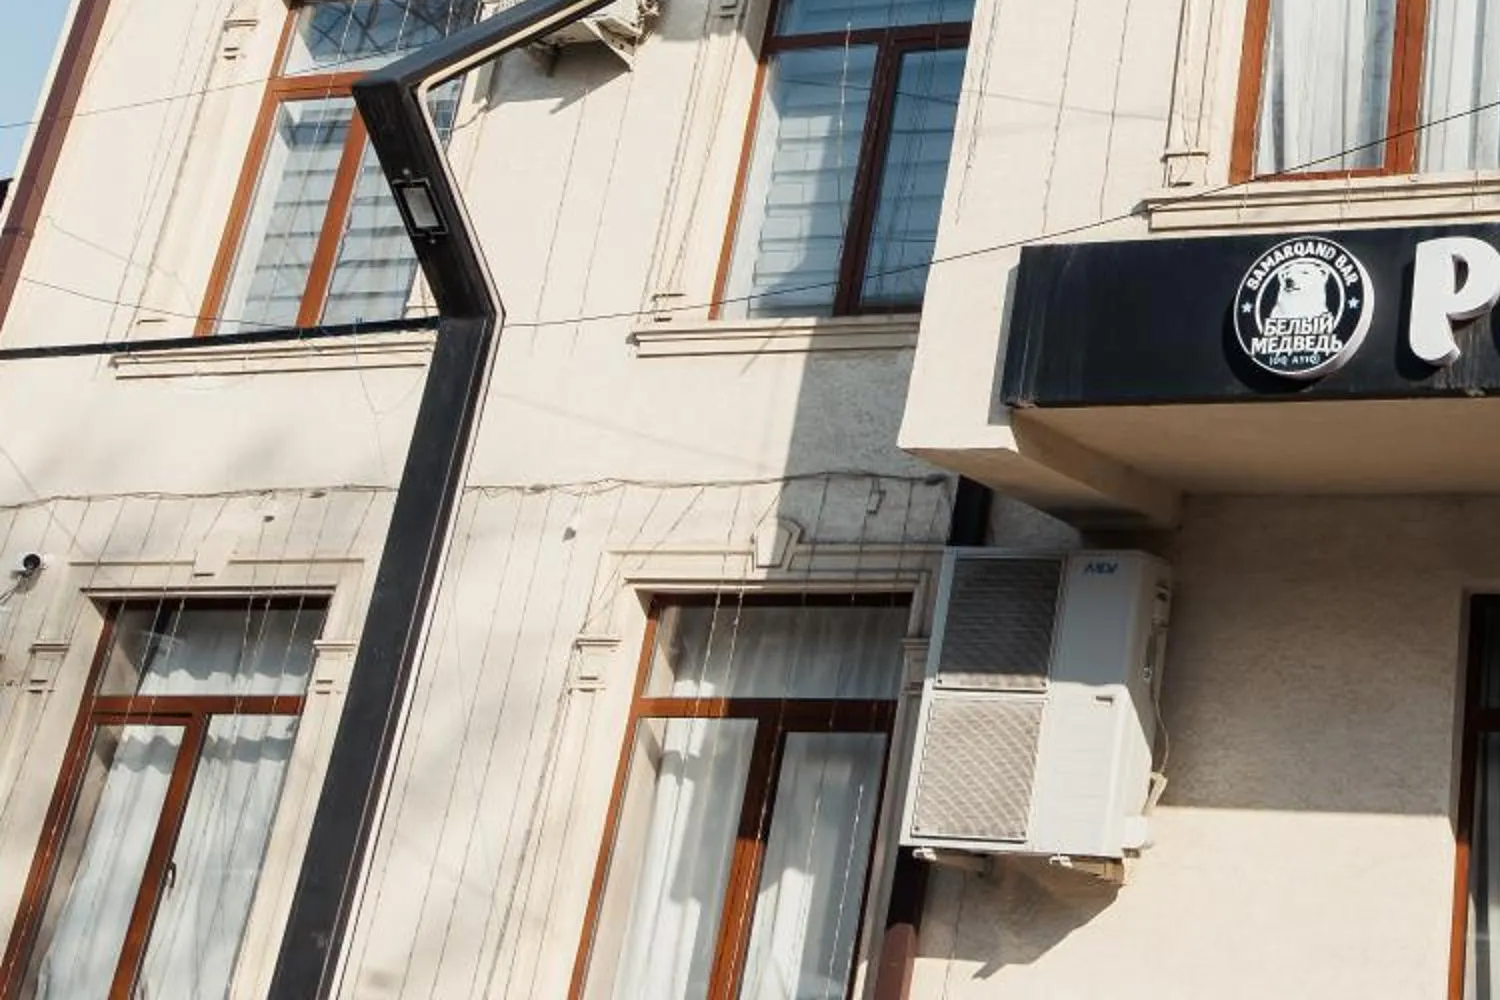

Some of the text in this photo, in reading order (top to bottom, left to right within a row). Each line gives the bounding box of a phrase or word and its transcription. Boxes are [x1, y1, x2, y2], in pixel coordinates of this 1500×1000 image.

[1246, 241, 1360, 292] SAMARQAND BAR
[1263, 311, 1335, 337] БЕЛЫЙ
[1251, 334, 1344, 357] МЕДВЕДЬ
